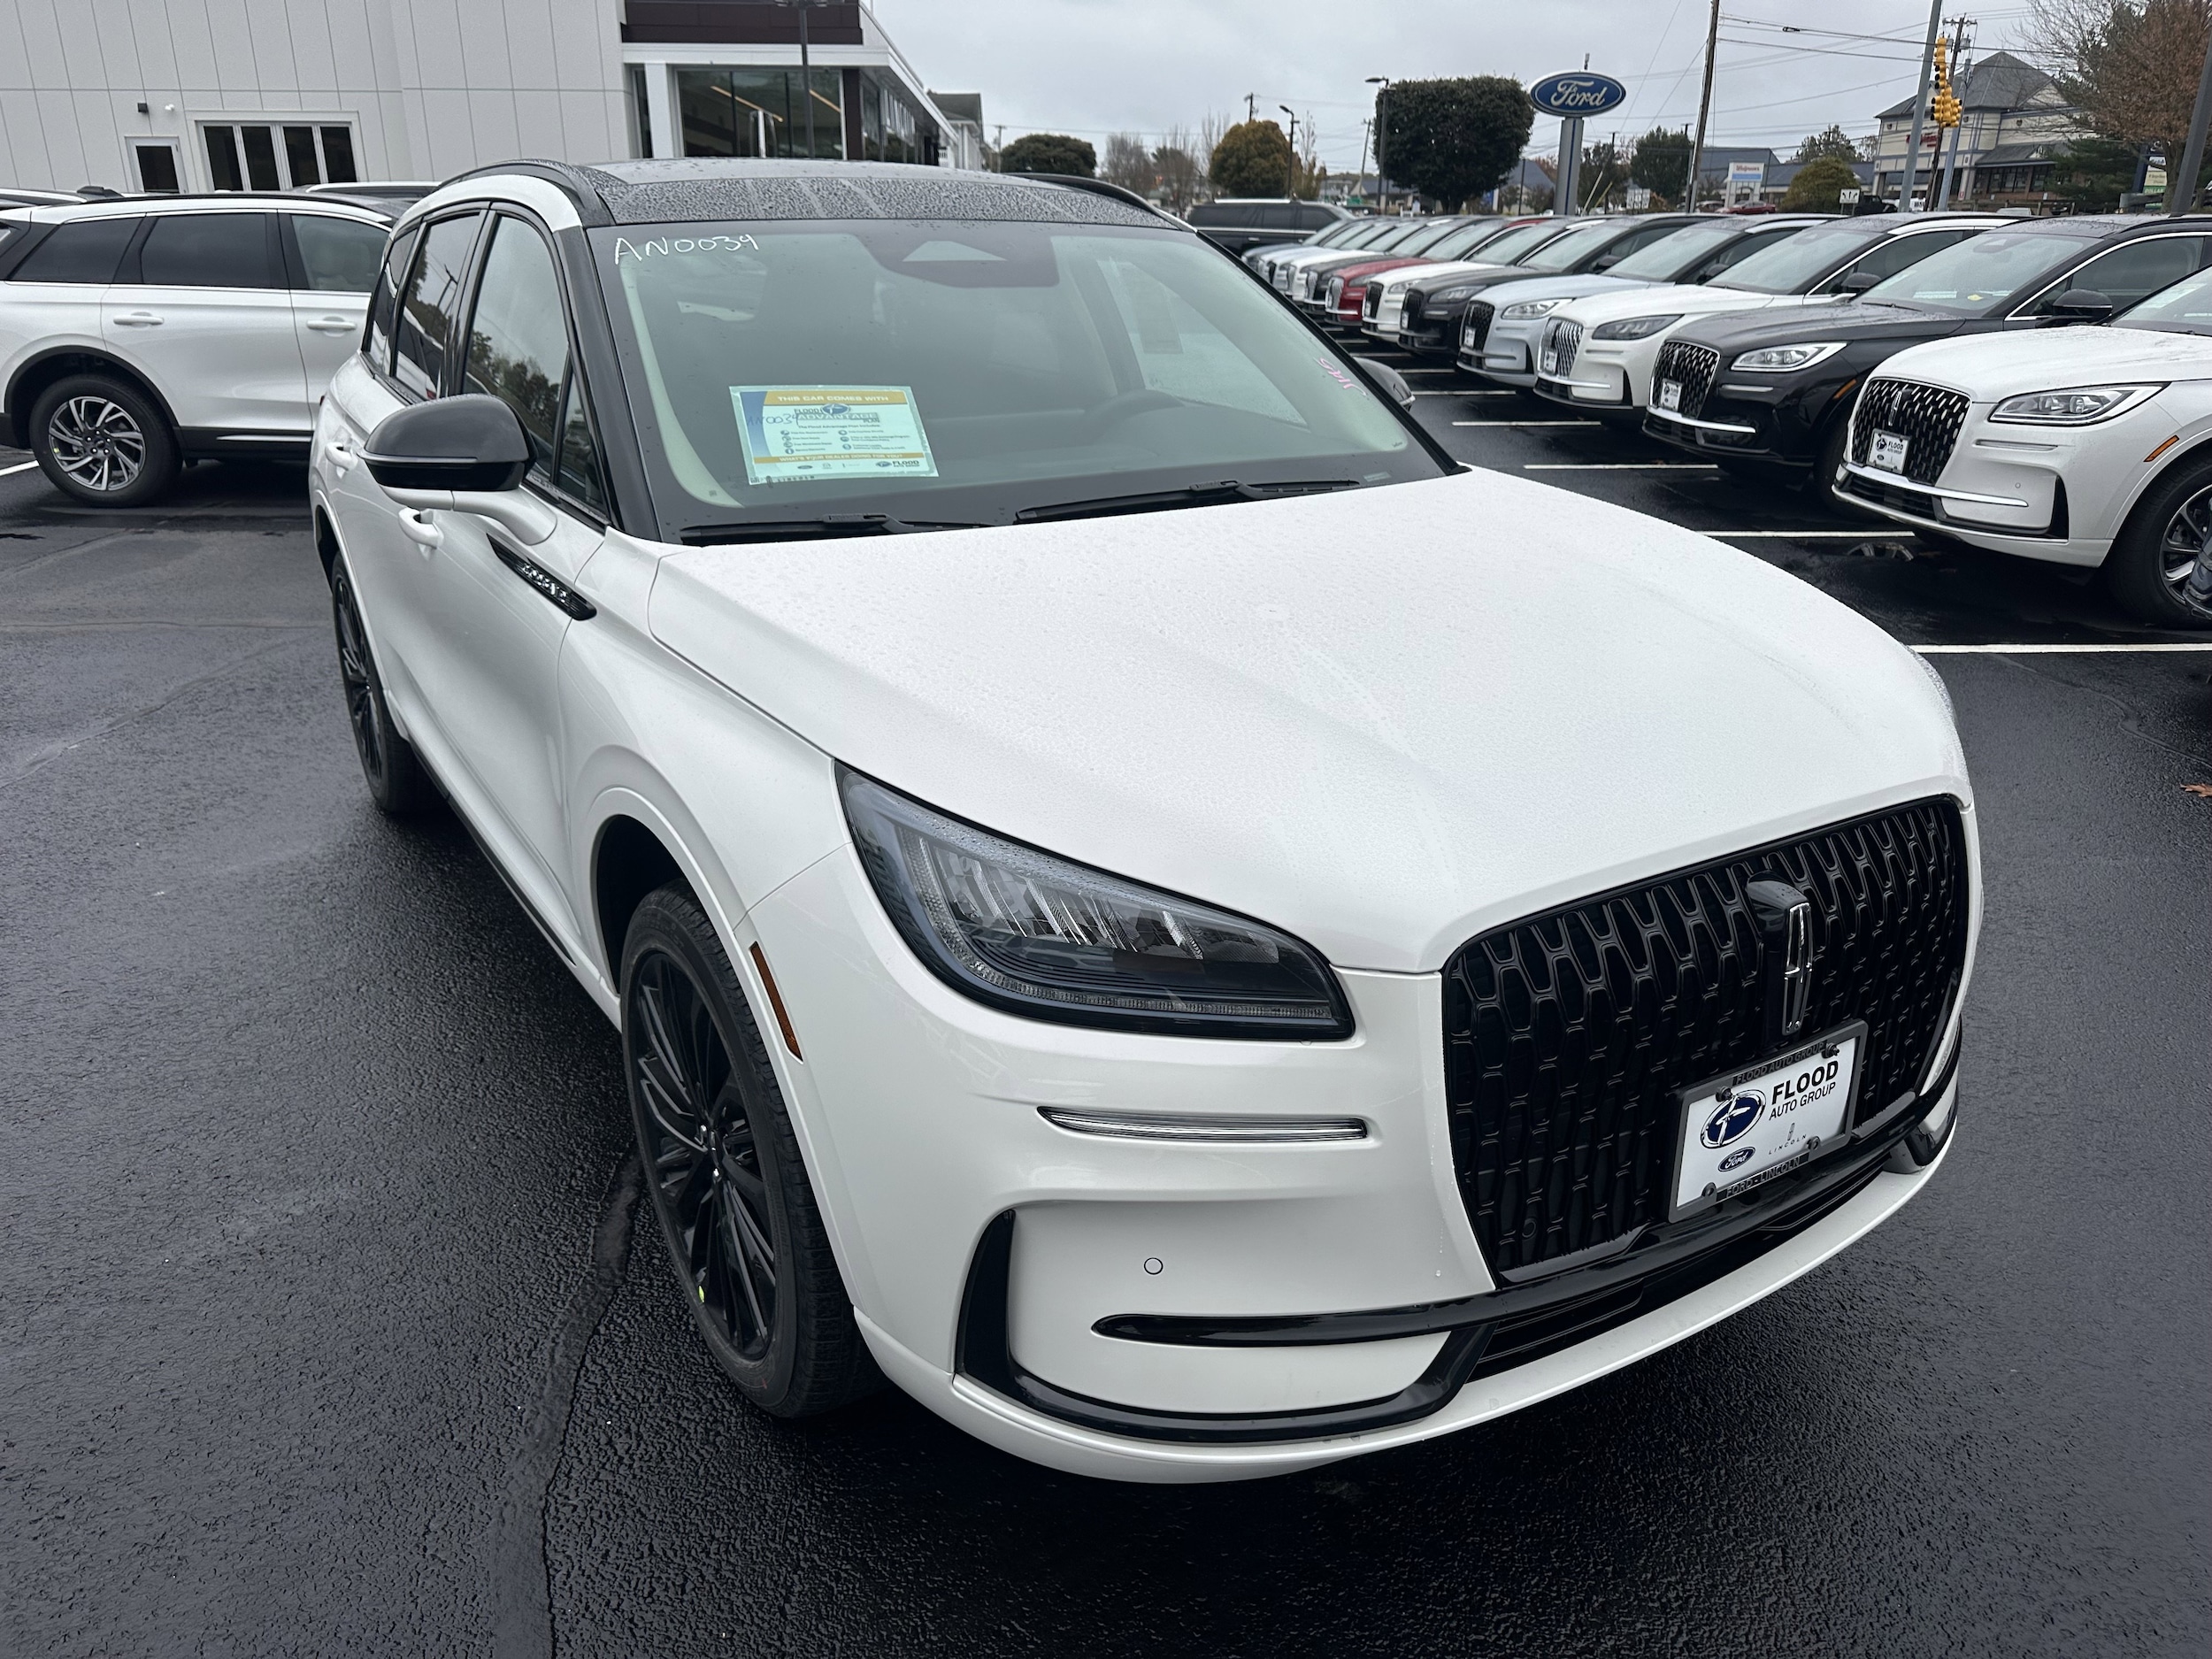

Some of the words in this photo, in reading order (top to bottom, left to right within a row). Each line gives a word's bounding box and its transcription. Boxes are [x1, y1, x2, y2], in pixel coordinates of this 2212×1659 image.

[1550, 80, 1608, 106] Ford
[1737, 1066, 1768, 1083] FLOOD
[1769, 1055, 1793, 1072] AUTO
[1794, 1042, 1824, 1062] GROUP
[1771, 1060, 1839, 1105] FLOOD
[1769, 1099, 1797, 1121] AUTO
[1800, 1081, 1836, 1107] GROUP
[1724, 1149, 1750, 1169] Ford
[1768, 1134, 1807, 1156] LINCOLN
[1725, 1178, 1753, 1199] FORD
[1760, 1156, 1801, 1182] LINCOLN
